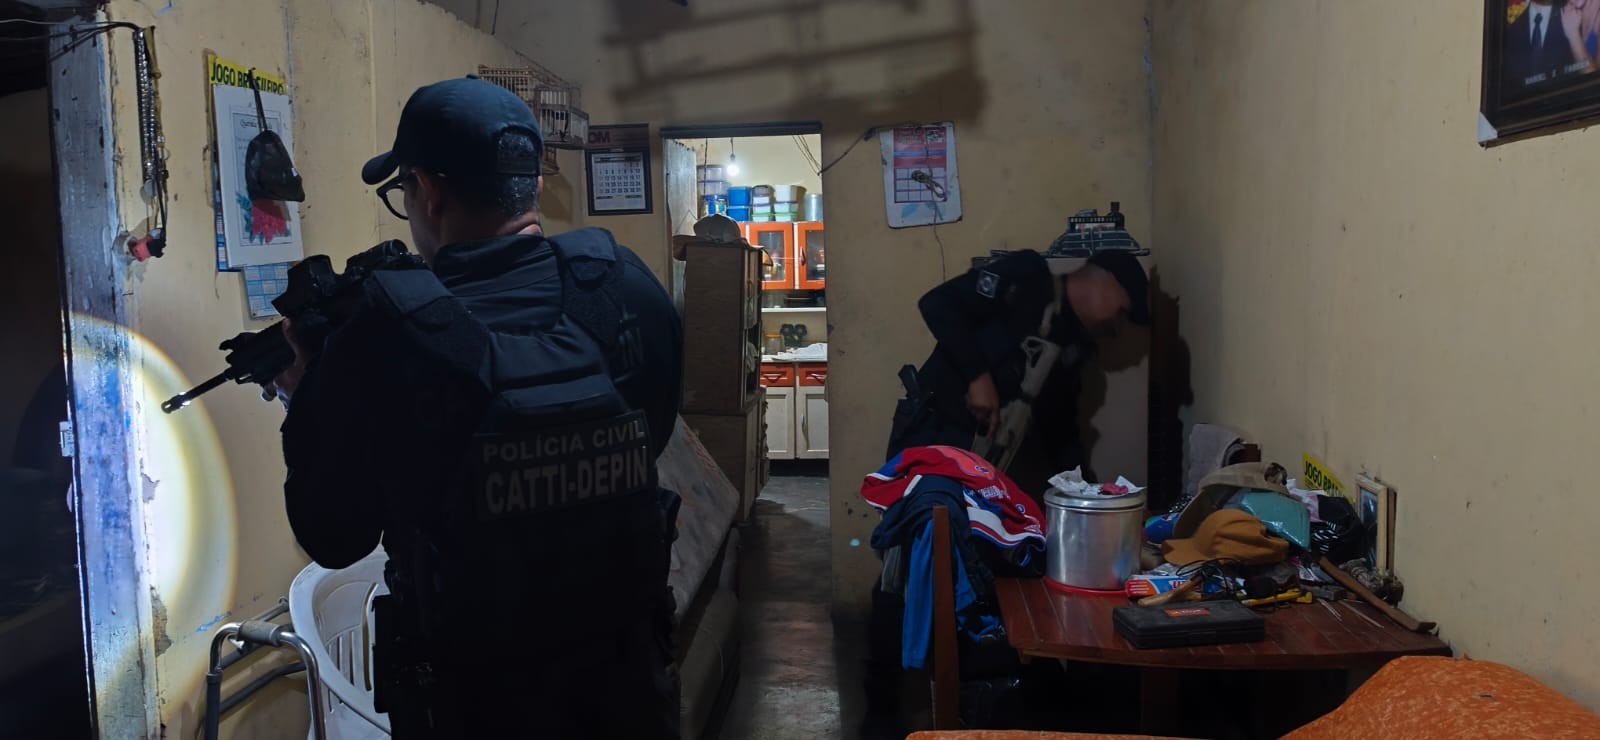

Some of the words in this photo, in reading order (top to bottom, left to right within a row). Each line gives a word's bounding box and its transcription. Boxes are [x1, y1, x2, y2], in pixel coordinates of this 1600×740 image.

[211, 62, 236, 86] JOGO
[483, 432, 585, 463] POLÍCIA
[592, 419, 646, 448] CIVIL
[485, 447, 648, 514] CATTI-DEPIN
[1304, 460, 1323, 487] JOGO
